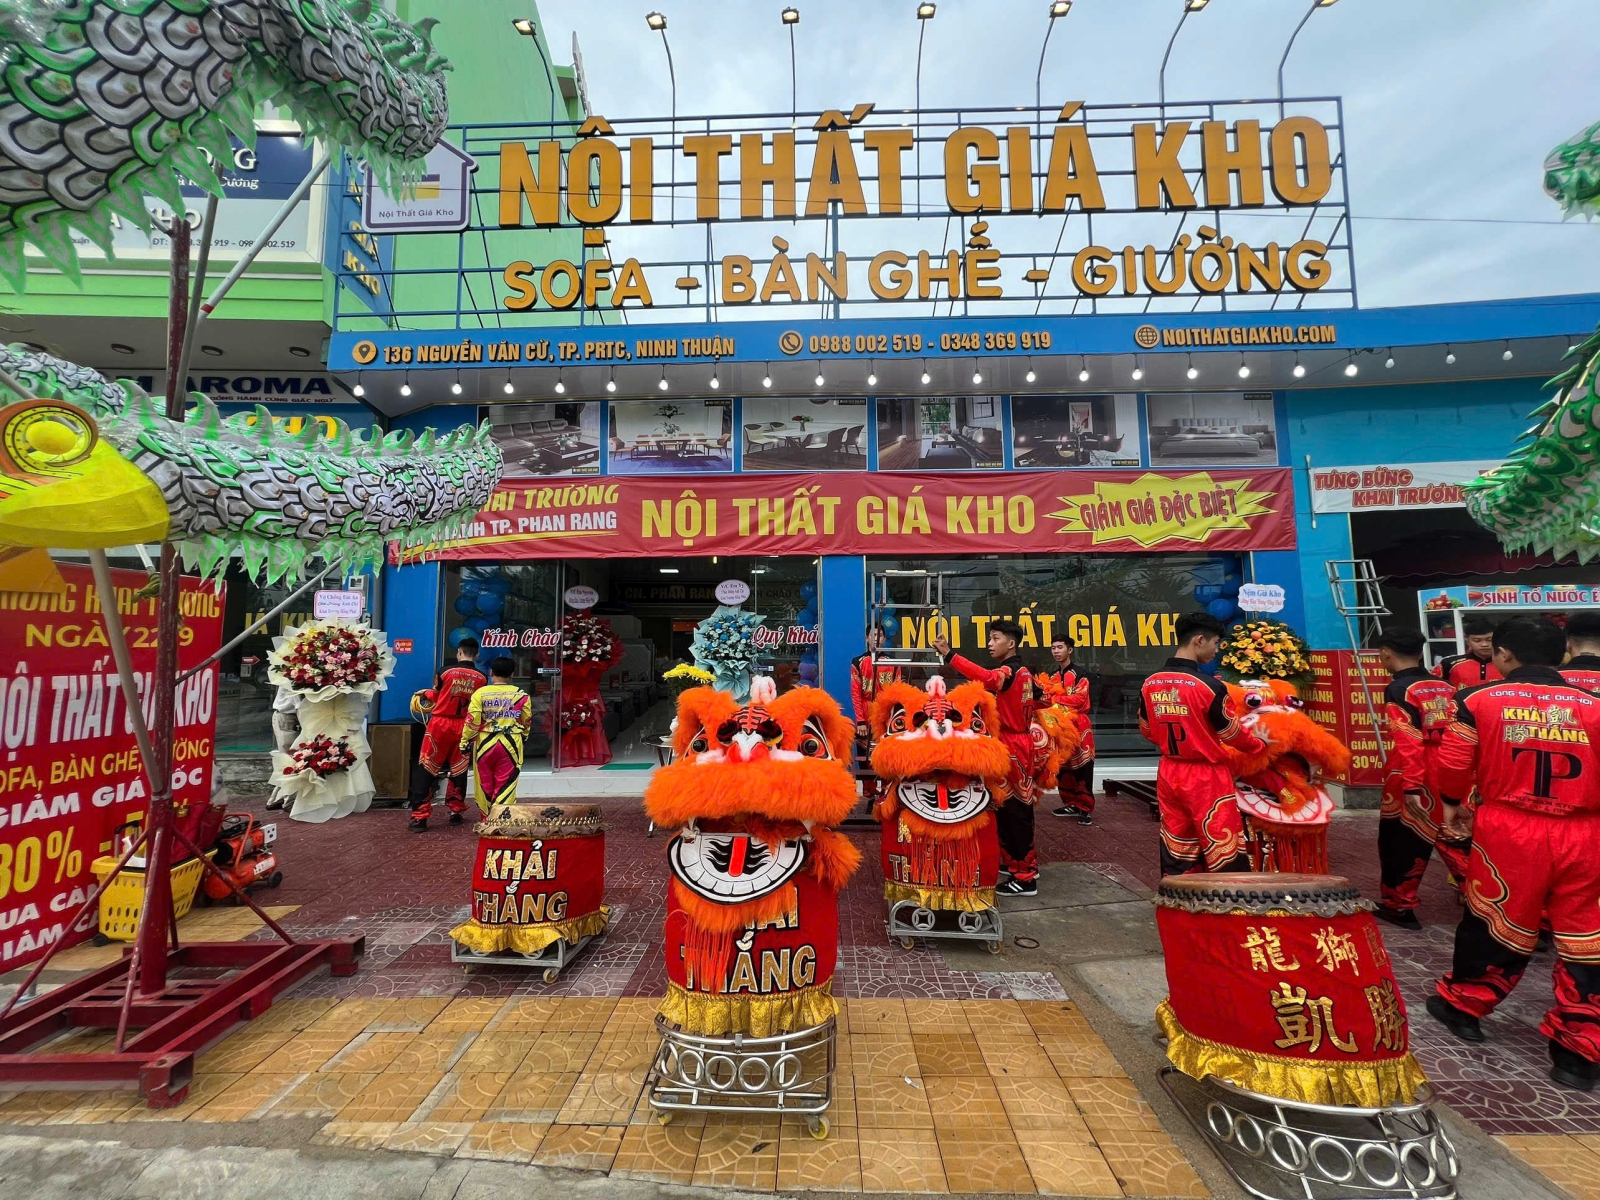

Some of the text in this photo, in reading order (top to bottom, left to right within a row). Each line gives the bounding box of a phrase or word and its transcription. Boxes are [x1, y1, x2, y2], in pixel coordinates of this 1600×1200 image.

[500, 101, 1332, 247] NỘI THẤT GIÁ KHO
[379, 209, 394, 218] Nội
[397, 209, 416, 217] Thất
[418, 209, 433, 217] Giá
[503, 258, 654, 311] SOFA
[722, 235, 848, 304] BÀN
[868, 220, 1003, 301] GHẾ
[1071, 225, 1332, 298] GIƯỜNG
[383, 345, 412, 363] 136
[416, 338, 483, 363] NGUYỄN
[488, 340, 521, 362] VĂN
[558, 343, 582, 360] TP.
[584, 341, 632, 361] PRTC,
[635, 338, 677, 358] NINH
[682, 334, 735, 362] THUẬN
[808, 333, 852, 354] 0988
[855, 333, 888, 353] 002
[892, 333, 923, 352] 519
[940, 332, 981, 351] 0348
[985, 332, 1017, 350] 369
[1020, 331, 1051, 350] 919
[1162, 325, 1337, 347] NOITHATGIAKHO.COM
[524, 484, 620, 510] TRƯƠNG
[1079, 484, 1238, 531] GIẢM GIÁ ĐẶC BIỆT
[1352, 487, 1396, 508] KHAI
[489, 517, 514, 536] TP.
[518, 514, 567, 533] PHAN
[570, 510, 618, 531] RANG
[641, 485, 1036, 547] NỘI THẤT GIÁ KHO
[1483, 586, 1600, 604] SINH TỐ NƯỚC É
[26, 619, 131, 648] NGÀ
[481, 627, 561, 648] Kính Chào
[752, 625, 785, 649] Quý
[1068, 605, 1127, 646] GIÁ
[1137, 612, 1181, 646] KH
[49, 655, 122, 744] THẤT
[1503, 705, 1548, 723] KHẢI
[0, 765, 43, 794] OFA,
[50, 753, 96, 785] BÀN
[1352, 755, 1383, 769] 30%
[92, 776, 146, 808] GIÁ
[171, 764, 203, 791] ỐC
[483, 840, 558, 880] KHẢI
[473, 880, 569, 924] THẮNG
